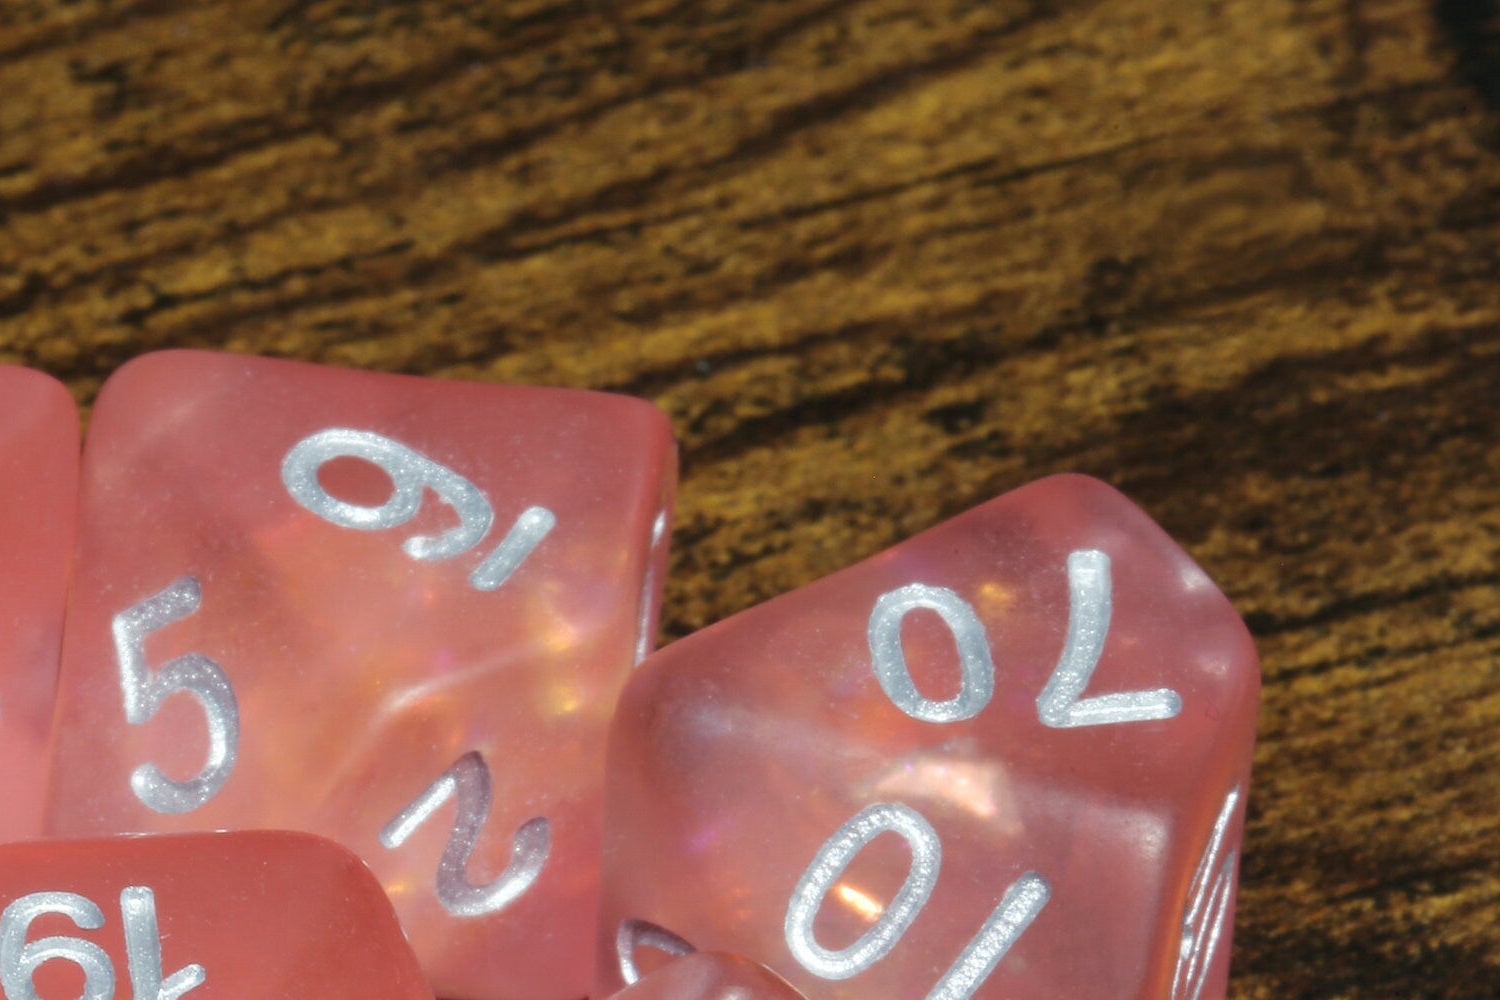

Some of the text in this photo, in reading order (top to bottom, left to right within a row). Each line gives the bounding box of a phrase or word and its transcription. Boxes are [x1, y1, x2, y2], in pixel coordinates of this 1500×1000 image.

[111, 576, 240, 814] 5
[868, 550, 1182, 728] 70
[379, 750, 551, 917] 2
